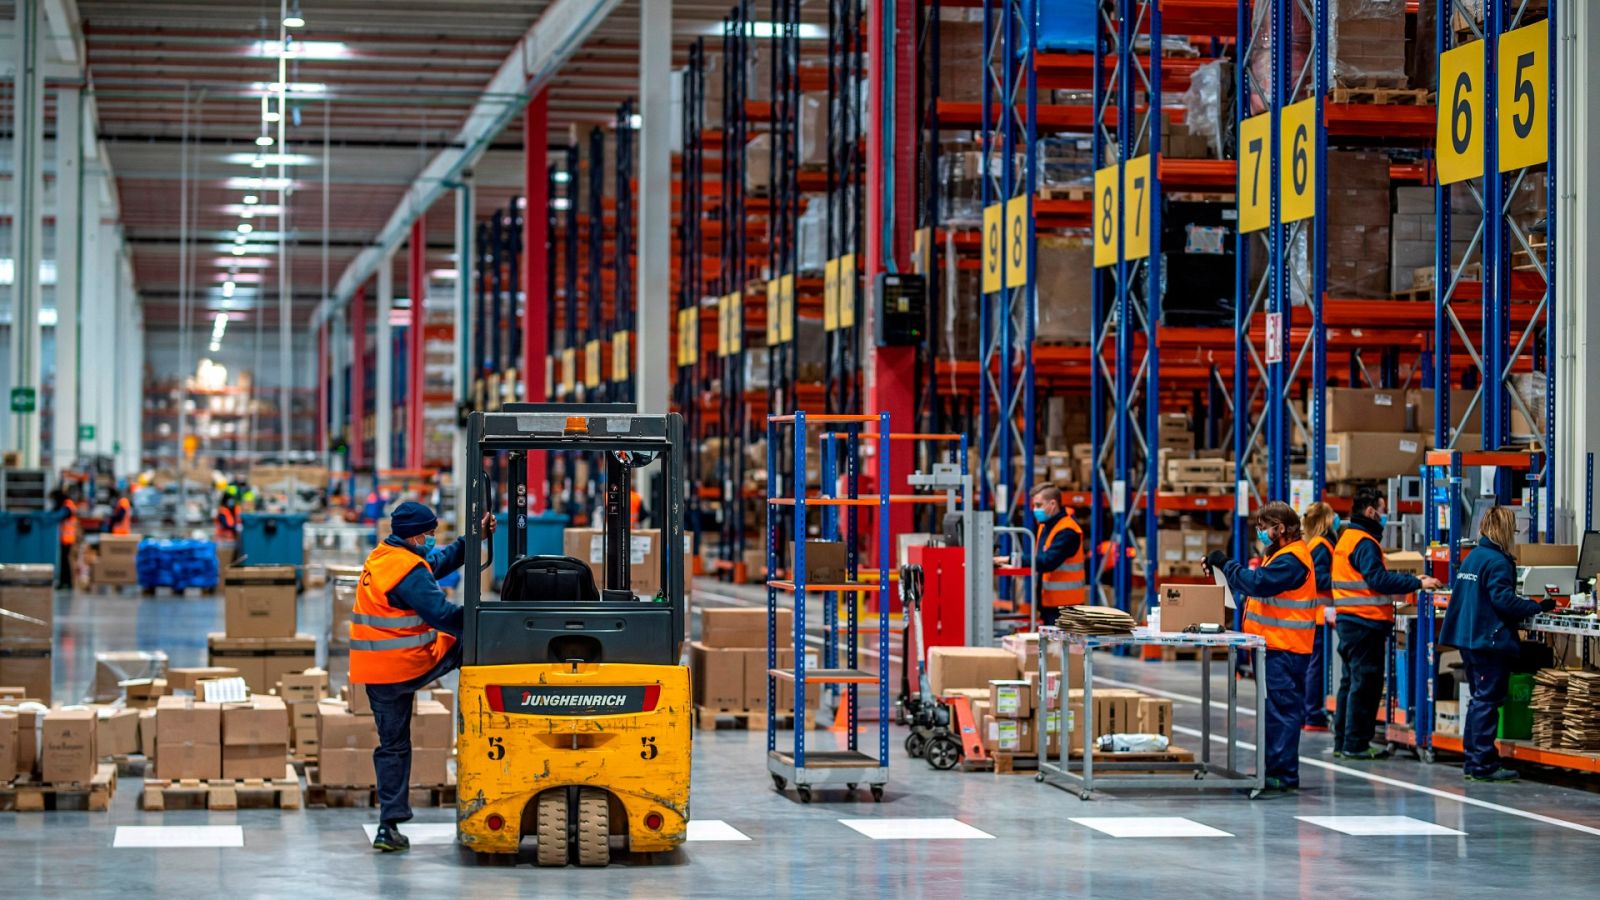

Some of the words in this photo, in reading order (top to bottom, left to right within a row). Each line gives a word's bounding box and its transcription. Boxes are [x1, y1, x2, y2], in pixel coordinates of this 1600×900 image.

[1452, 71, 1473, 155] 6
[1512, 50, 1536, 140] 5
[1248, 137, 1264, 207] 7
[1292, 123, 1308, 196] 6
[1101, 186, 1113, 246] 8
[1133, 176, 1145, 238] 7
[989, 222, 998, 273] 9
[1013, 215, 1022, 269] 8
[521, 693, 627, 706] JUNGHEINRICH
[487, 736, 506, 761] 5
[640, 736, 658, 761] 5
